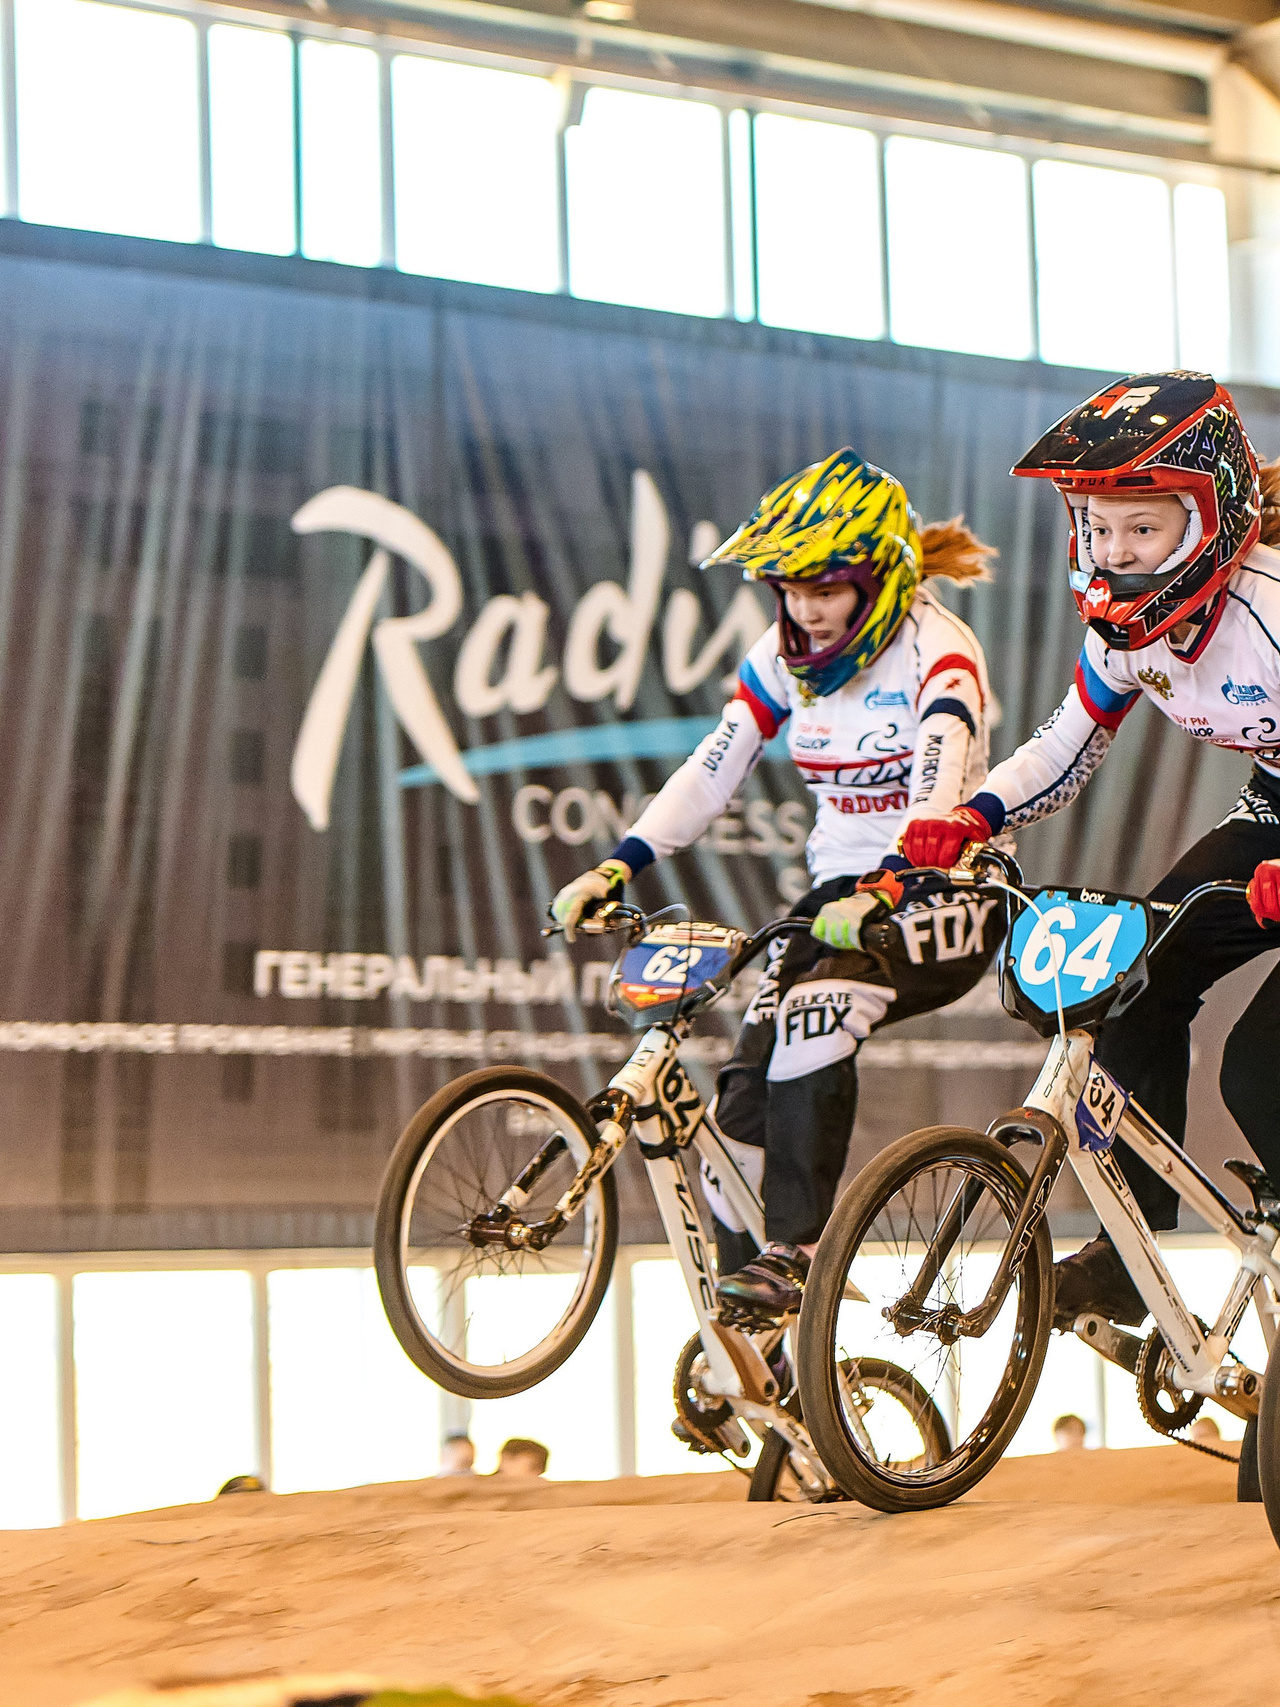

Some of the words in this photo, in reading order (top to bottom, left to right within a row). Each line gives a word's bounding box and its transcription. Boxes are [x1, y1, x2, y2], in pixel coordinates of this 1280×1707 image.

[702, 721, 738, 778] USSIA
[512, 784, 808, 855] CONESS
[1080, 888, 1107, 904] box
[900, 899, 998, 965] FOX
[1019, 906, 1123, 992] 64
[253, 949, 572, 1006] ГЕНЕРАЛЬНЫЙ
[642, 946, 702, 984] 62
[786, 1006, 851, 1046] FOX
[1090, 1072, 1115, 1127] 64
